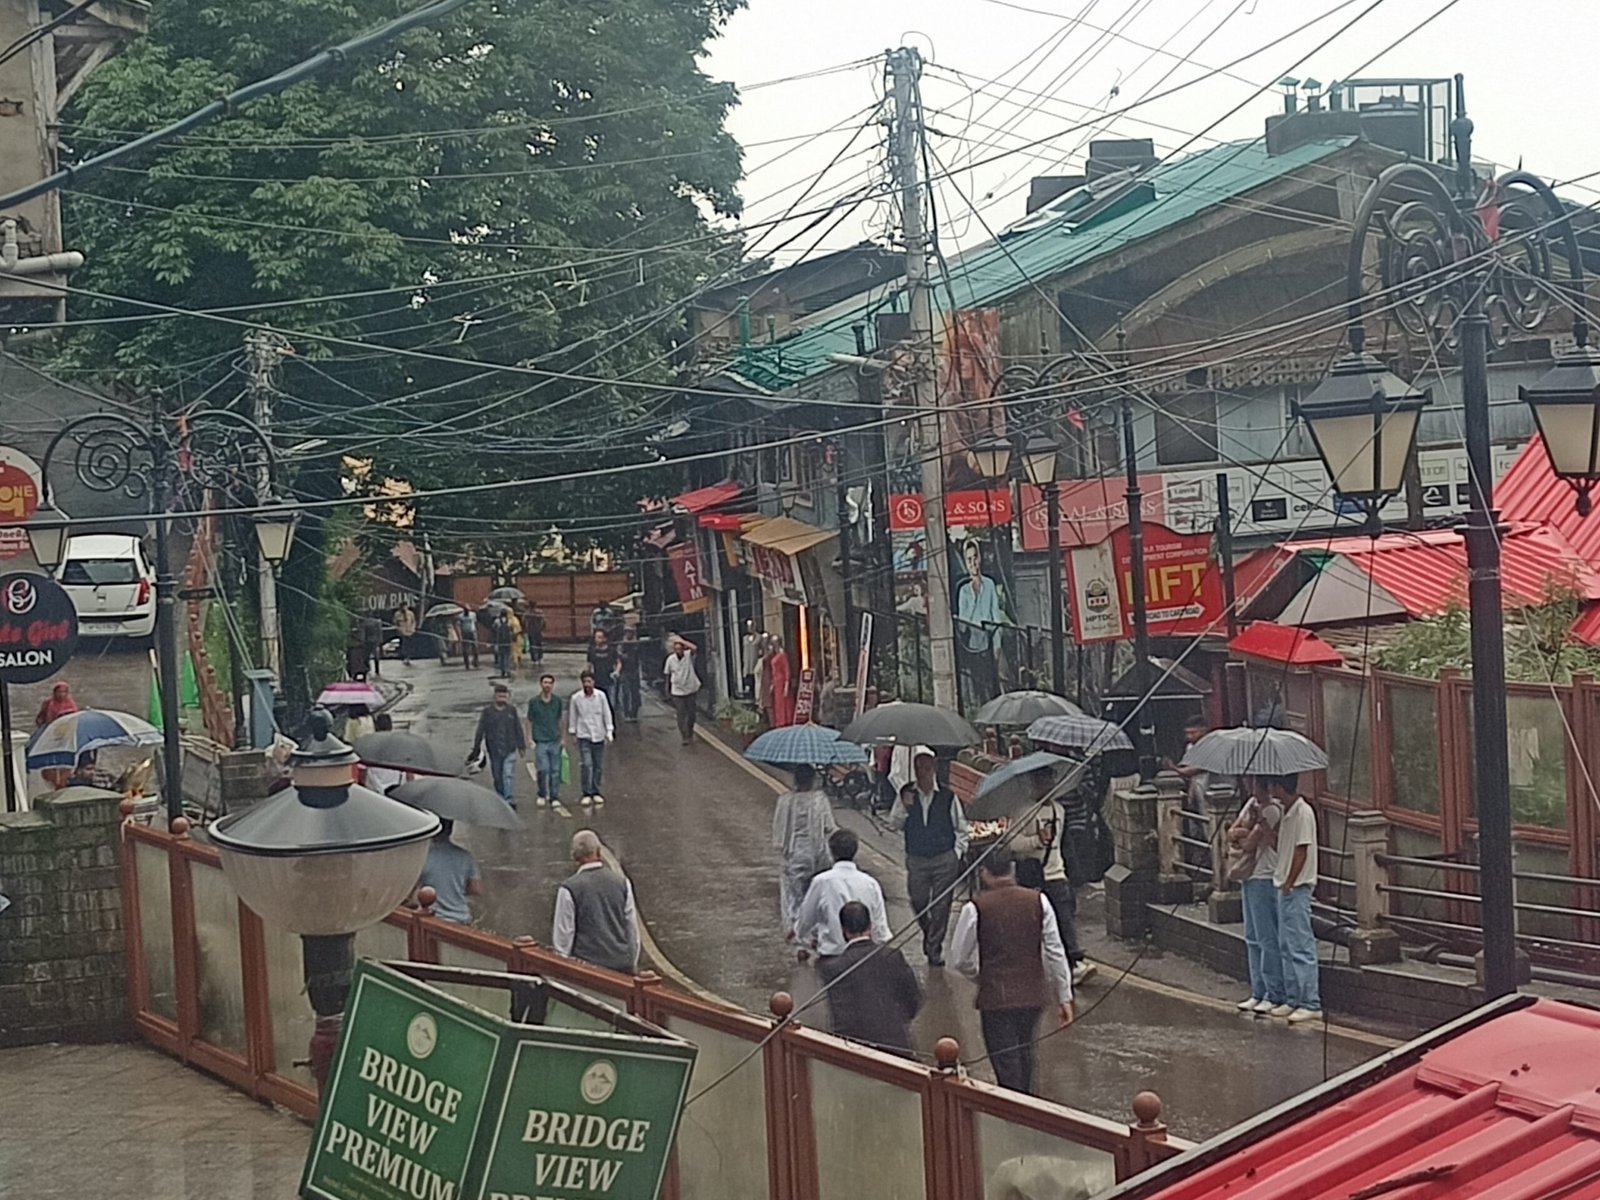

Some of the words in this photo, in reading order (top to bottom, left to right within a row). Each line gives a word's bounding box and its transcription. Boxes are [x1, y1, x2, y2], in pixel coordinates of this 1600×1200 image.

[684, 560, 703, 600] ATM
[1124, 562, 1207, 605] LIFT
[0, 649, 53, 667] SALON
[359, 1046, 463, 1124] BRIDGE
[367, 1093, 438, 1155] VIEW
[521, 1109, 650, 1152] BRIDGE
[325, 1120, 456, 1200] PREMIUM
[535, 1153, 624, 1192] VIEW
